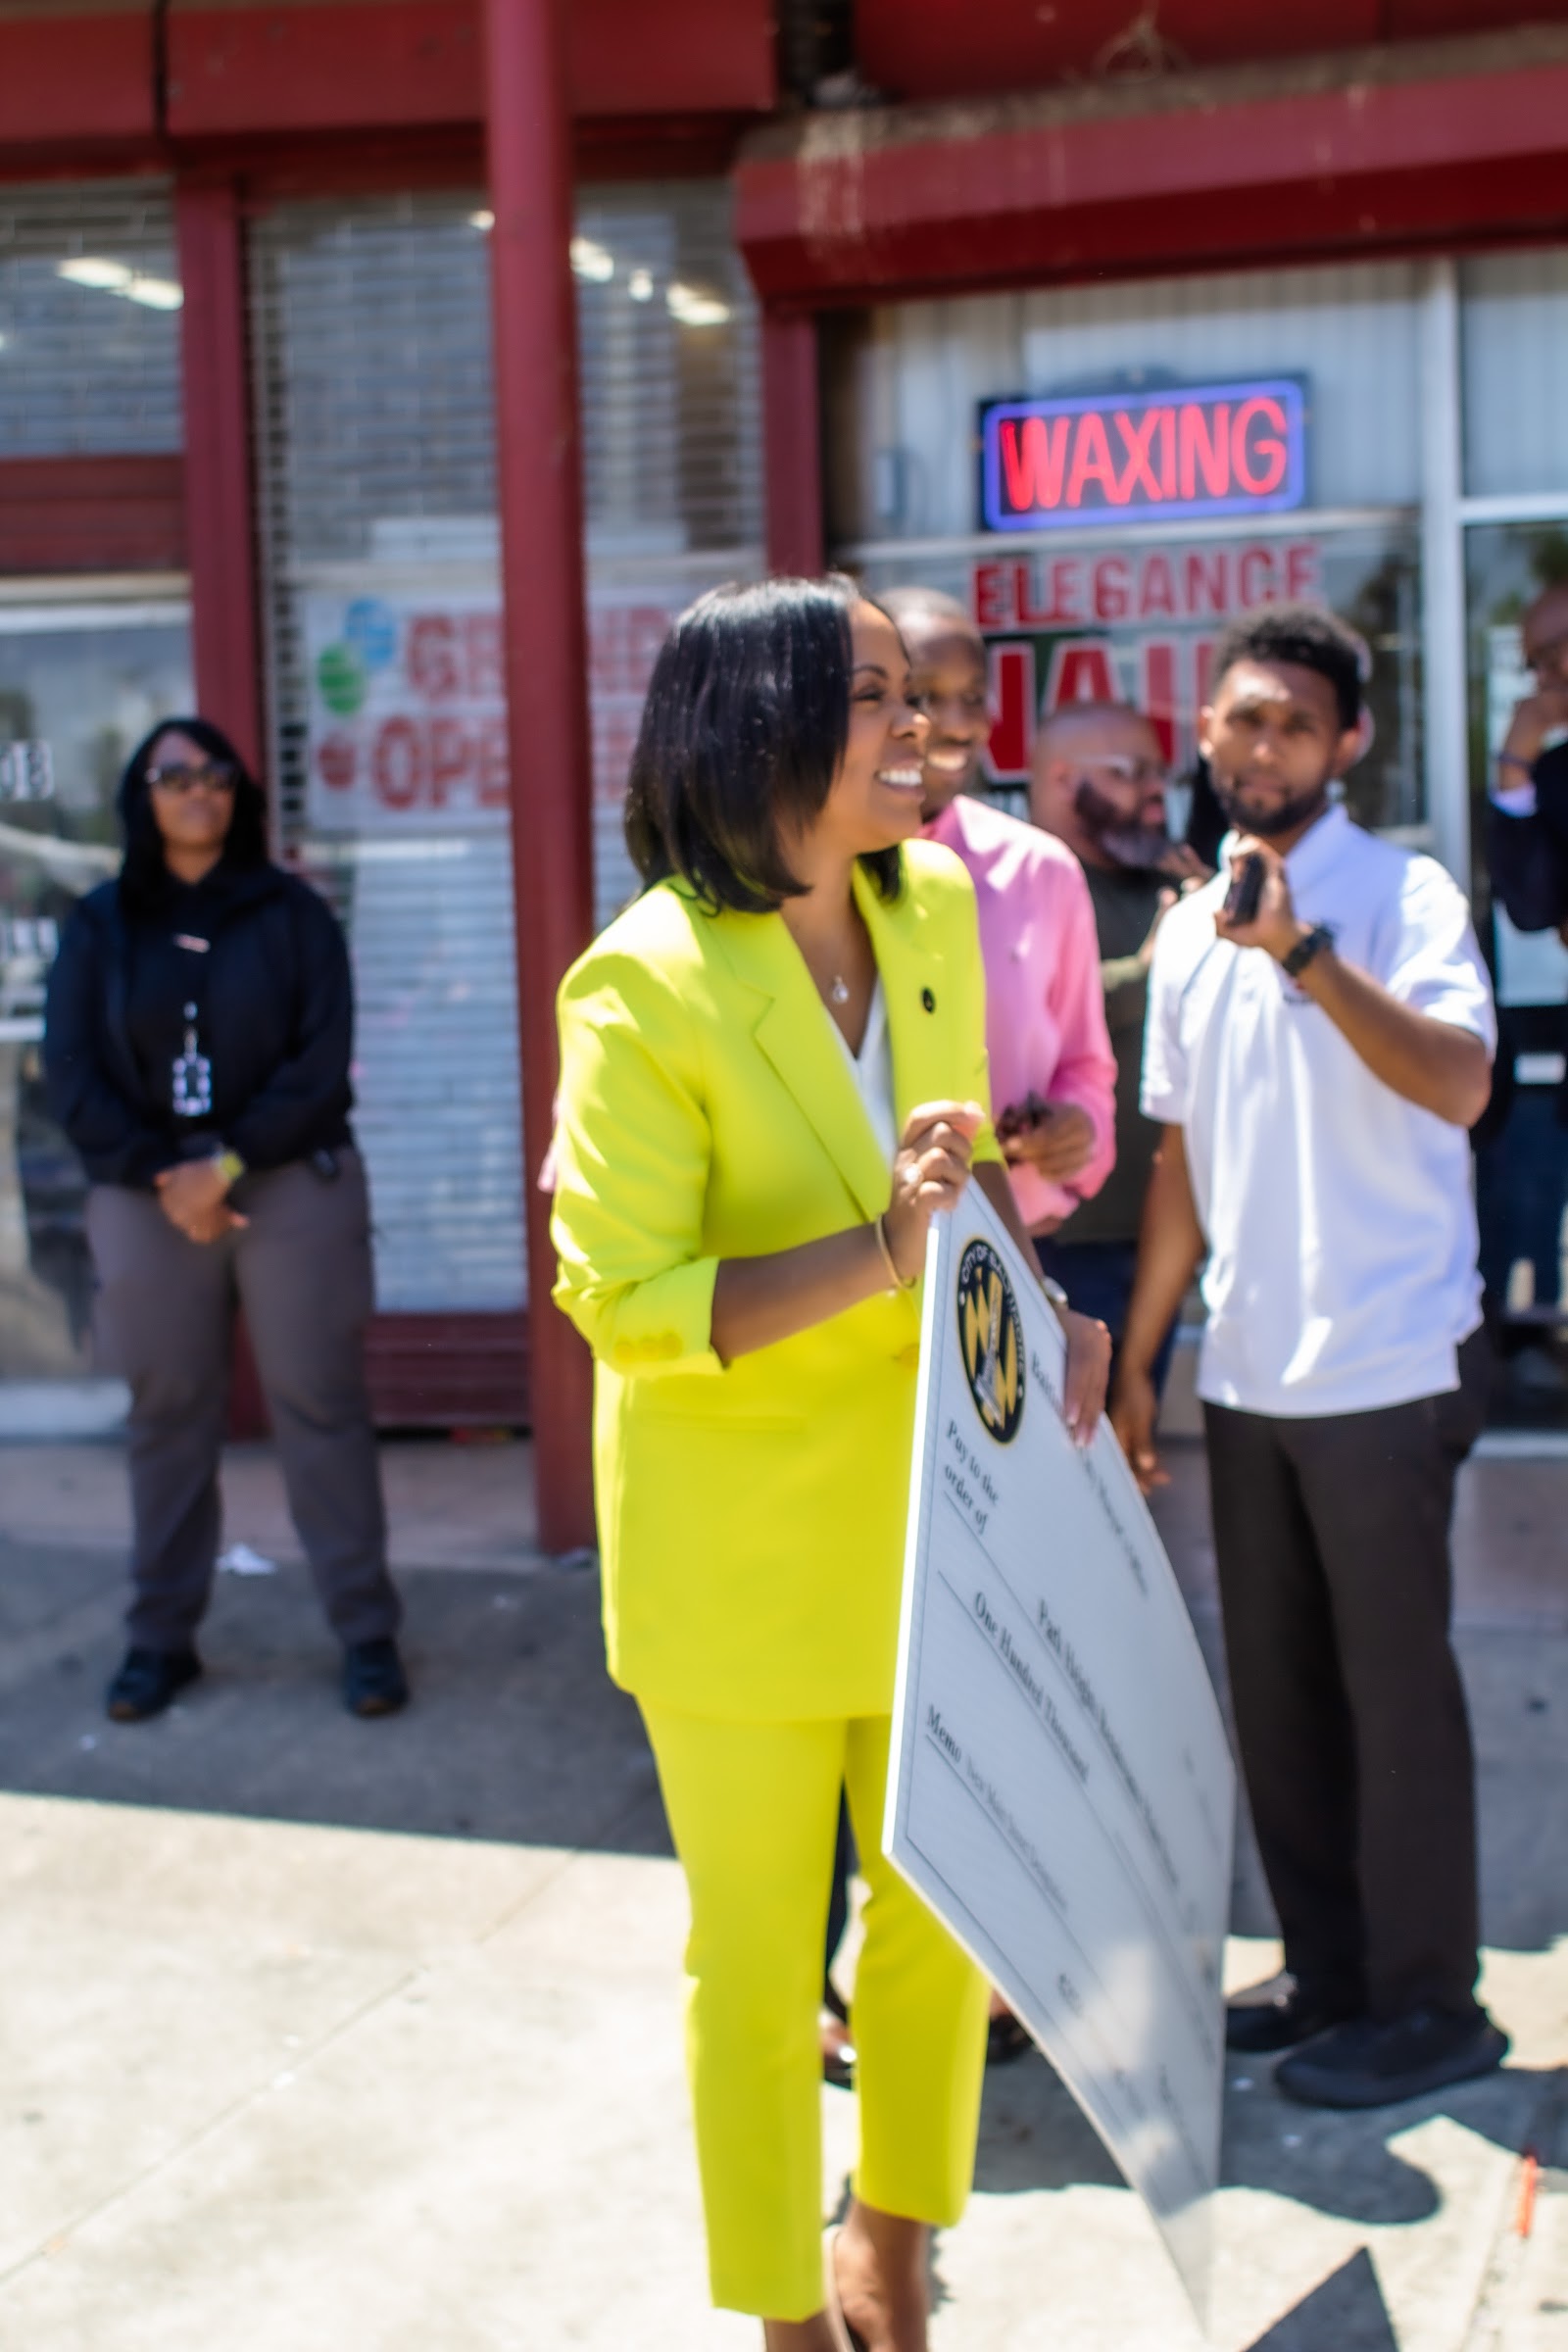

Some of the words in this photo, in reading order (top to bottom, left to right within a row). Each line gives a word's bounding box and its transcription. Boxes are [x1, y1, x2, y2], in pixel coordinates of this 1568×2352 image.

[999, 396, 1288, 512] WAXING
[973, 543, 1320, 628] ELEGANCE
[944, 1464, 973, 1510] order
[975, 1508, 988, 1536] of
[947, 1418, 968, 1464] Pay
[969, 1454, 982, 1480] to
[982, 1472, 1000, 1506] the
[975, 1591, 998, 1640] One
[1000, 1626, 1045, 1709] Hundred
[927, 1703, 962, 1764] Memo
